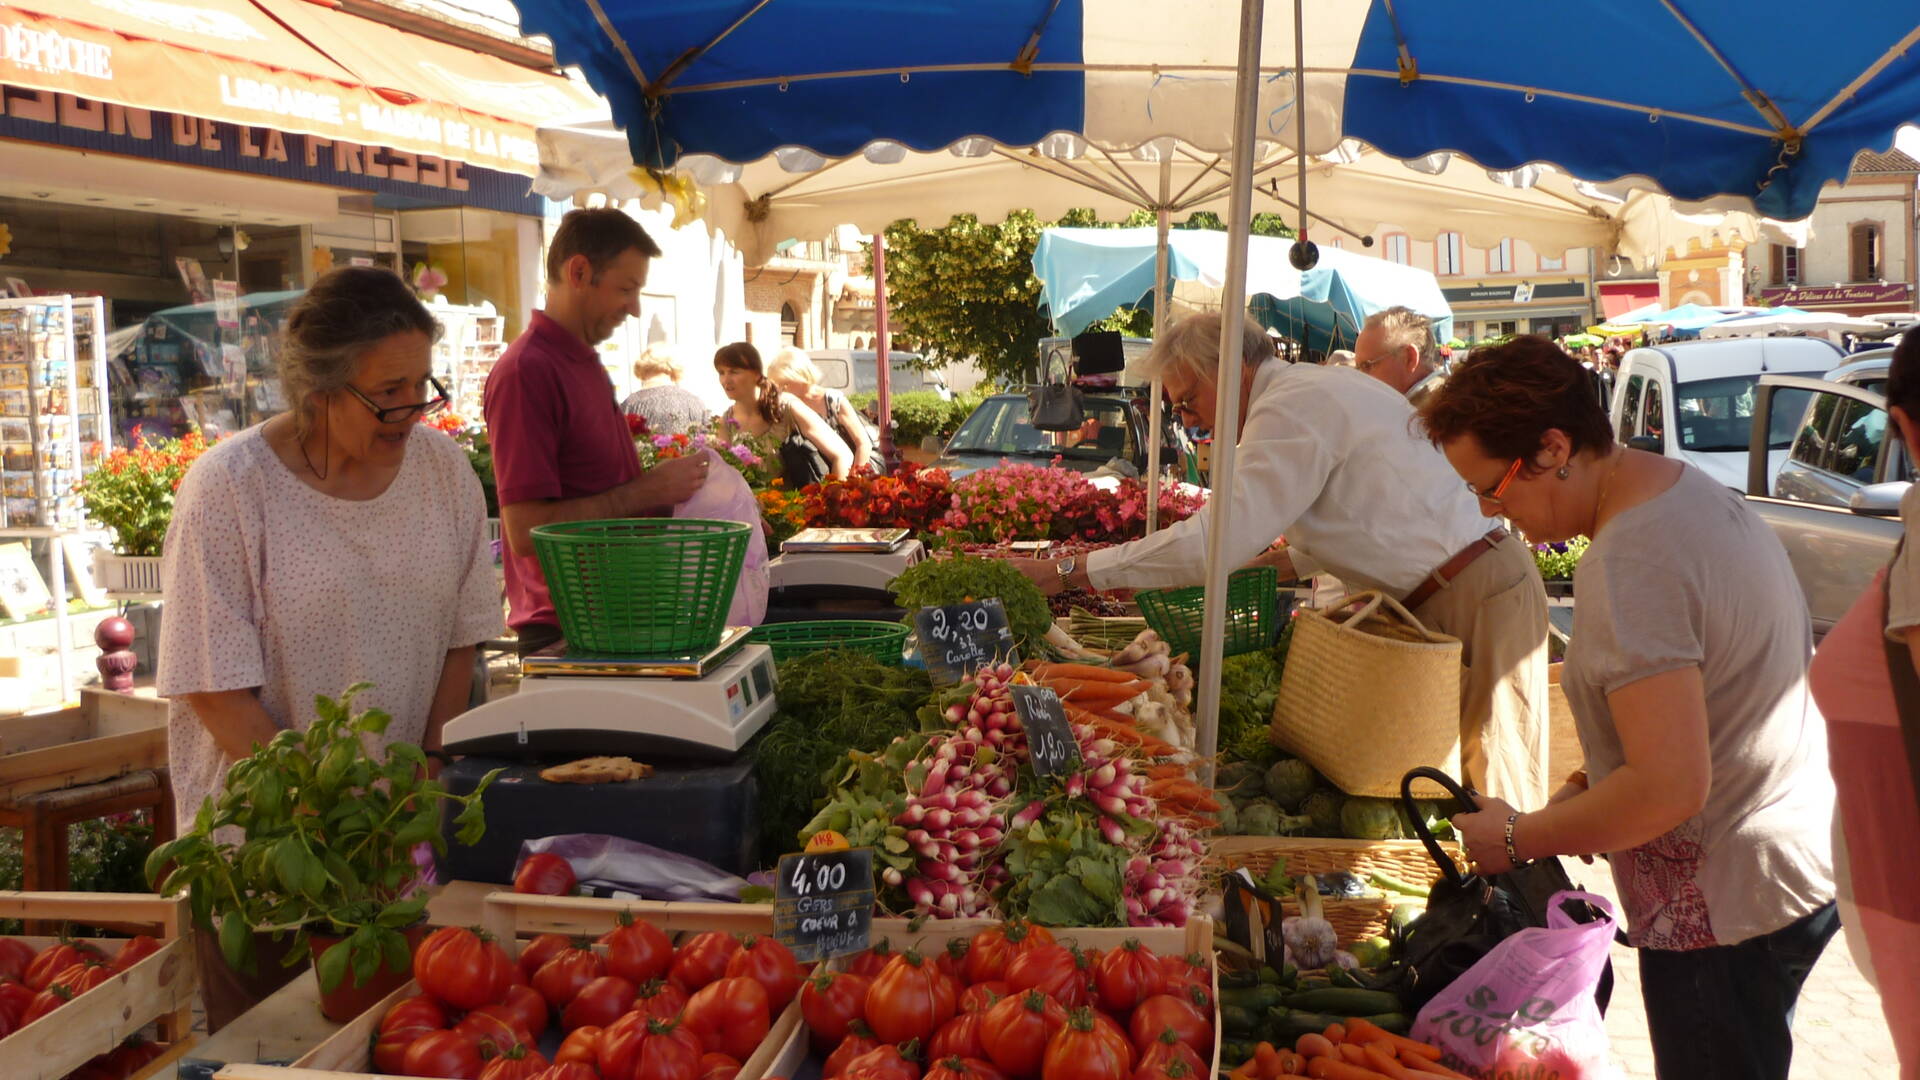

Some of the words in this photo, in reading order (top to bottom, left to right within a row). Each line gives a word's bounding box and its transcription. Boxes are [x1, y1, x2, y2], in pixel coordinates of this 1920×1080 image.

[239, 126, 288, 162] LA
[360, 103, 442, 144] MAISON
[444, 118, 471, 149] DE
[474, 127, 499, 157] LA
